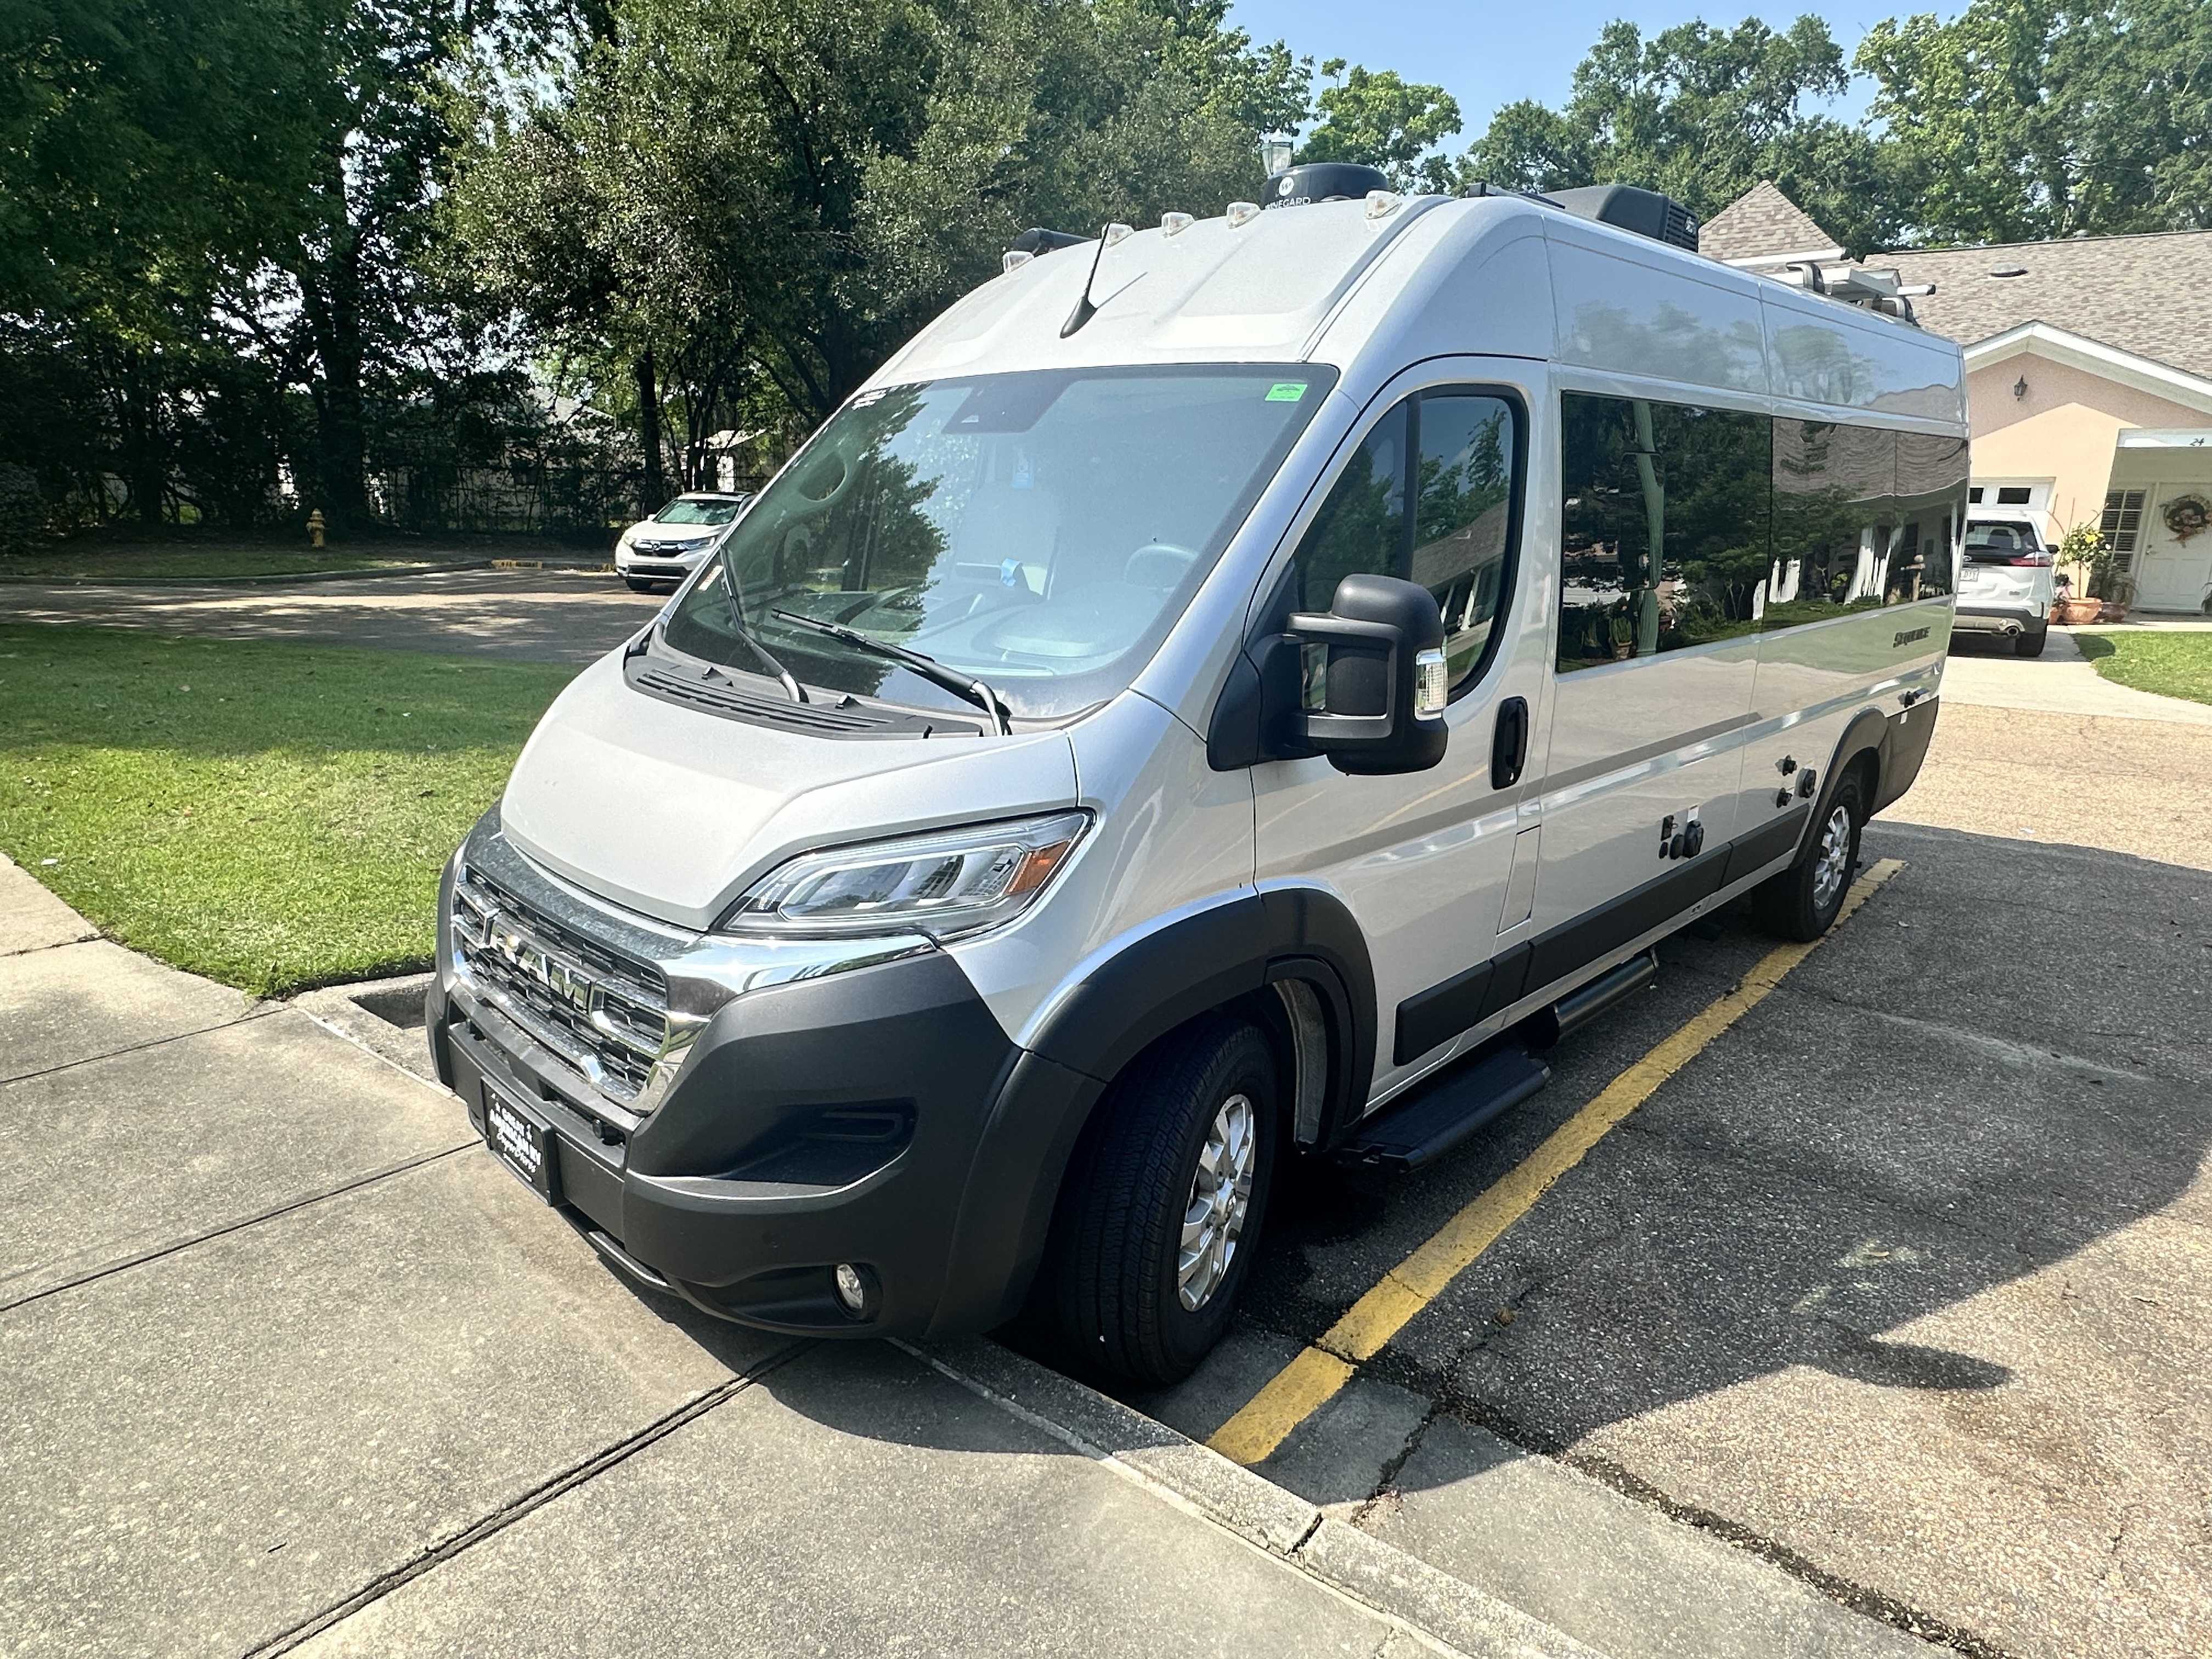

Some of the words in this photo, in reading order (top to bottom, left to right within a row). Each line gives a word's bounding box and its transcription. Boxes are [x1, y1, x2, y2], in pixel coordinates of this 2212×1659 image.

[491, 922, 591, 1016] RAM
[489, 1108, 529, 1155] AMERICAN
[529, 1144, 541, 1166] RV
[502, 1107, 524, 1137] GREAT
